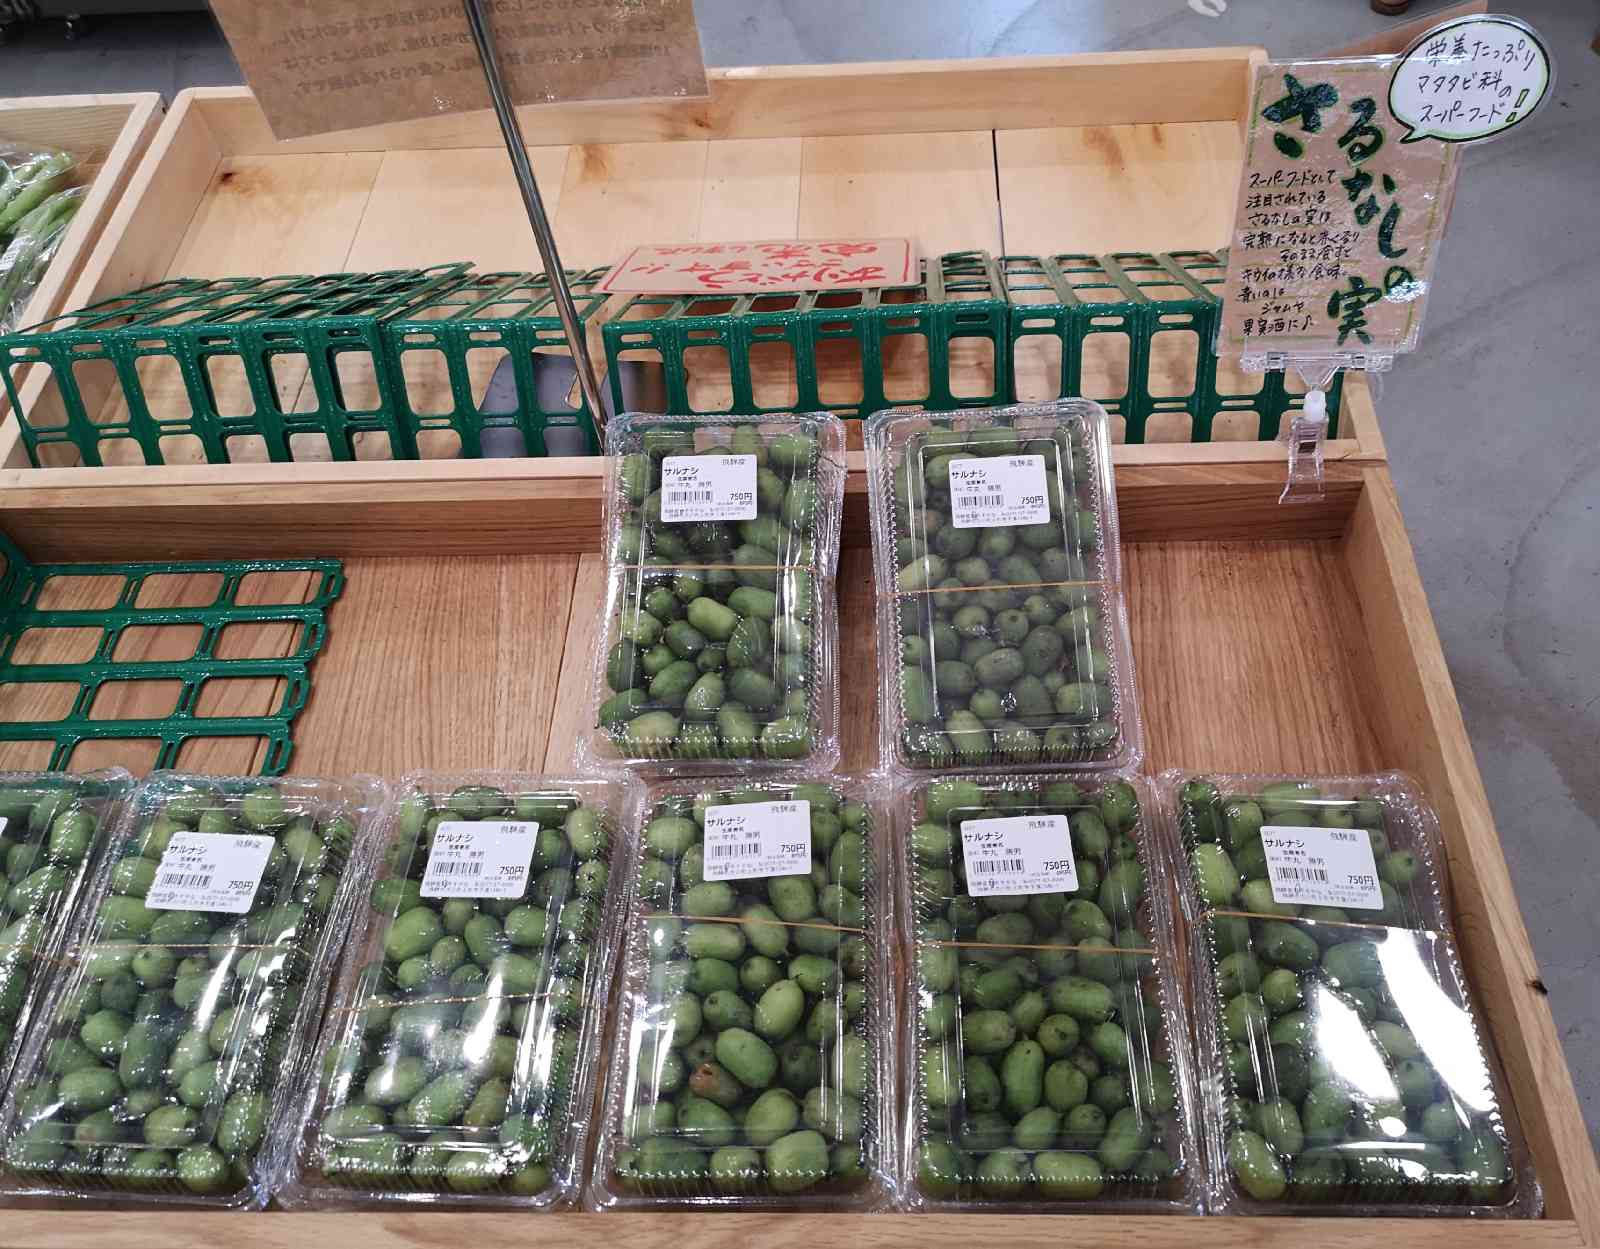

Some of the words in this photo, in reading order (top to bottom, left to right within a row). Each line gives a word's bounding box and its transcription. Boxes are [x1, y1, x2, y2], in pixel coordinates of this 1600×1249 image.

[1418, 70, 1511, 98] マタタビ科の
[1246, 190, 1326, 208] 注目されている
[696, 267, 886, 289] ありがとう
[664, 467, 700, 476] サルナシ
[952, 470, 987, 479] サルナシ
[729, 493, 753, 501] 750円
[1021, 496, 1044, 505] 750円
[707, 817, 746, 826] サルナシ
[437, 834, 474, 843] サルナシ
[964, 832, 1004, 842] サルナシ
[781, 843, 806, 853] 750円
[1264, 839, 1305, 848] サルナシ
[170, 846, 207, 856] サルナシ
[1043, 860, 1070, 870] 750円
[499, 866, 525, 875] 750円
[228, 880, 254, 890] 750円
[1347, 875, 1374, 886] 750円
